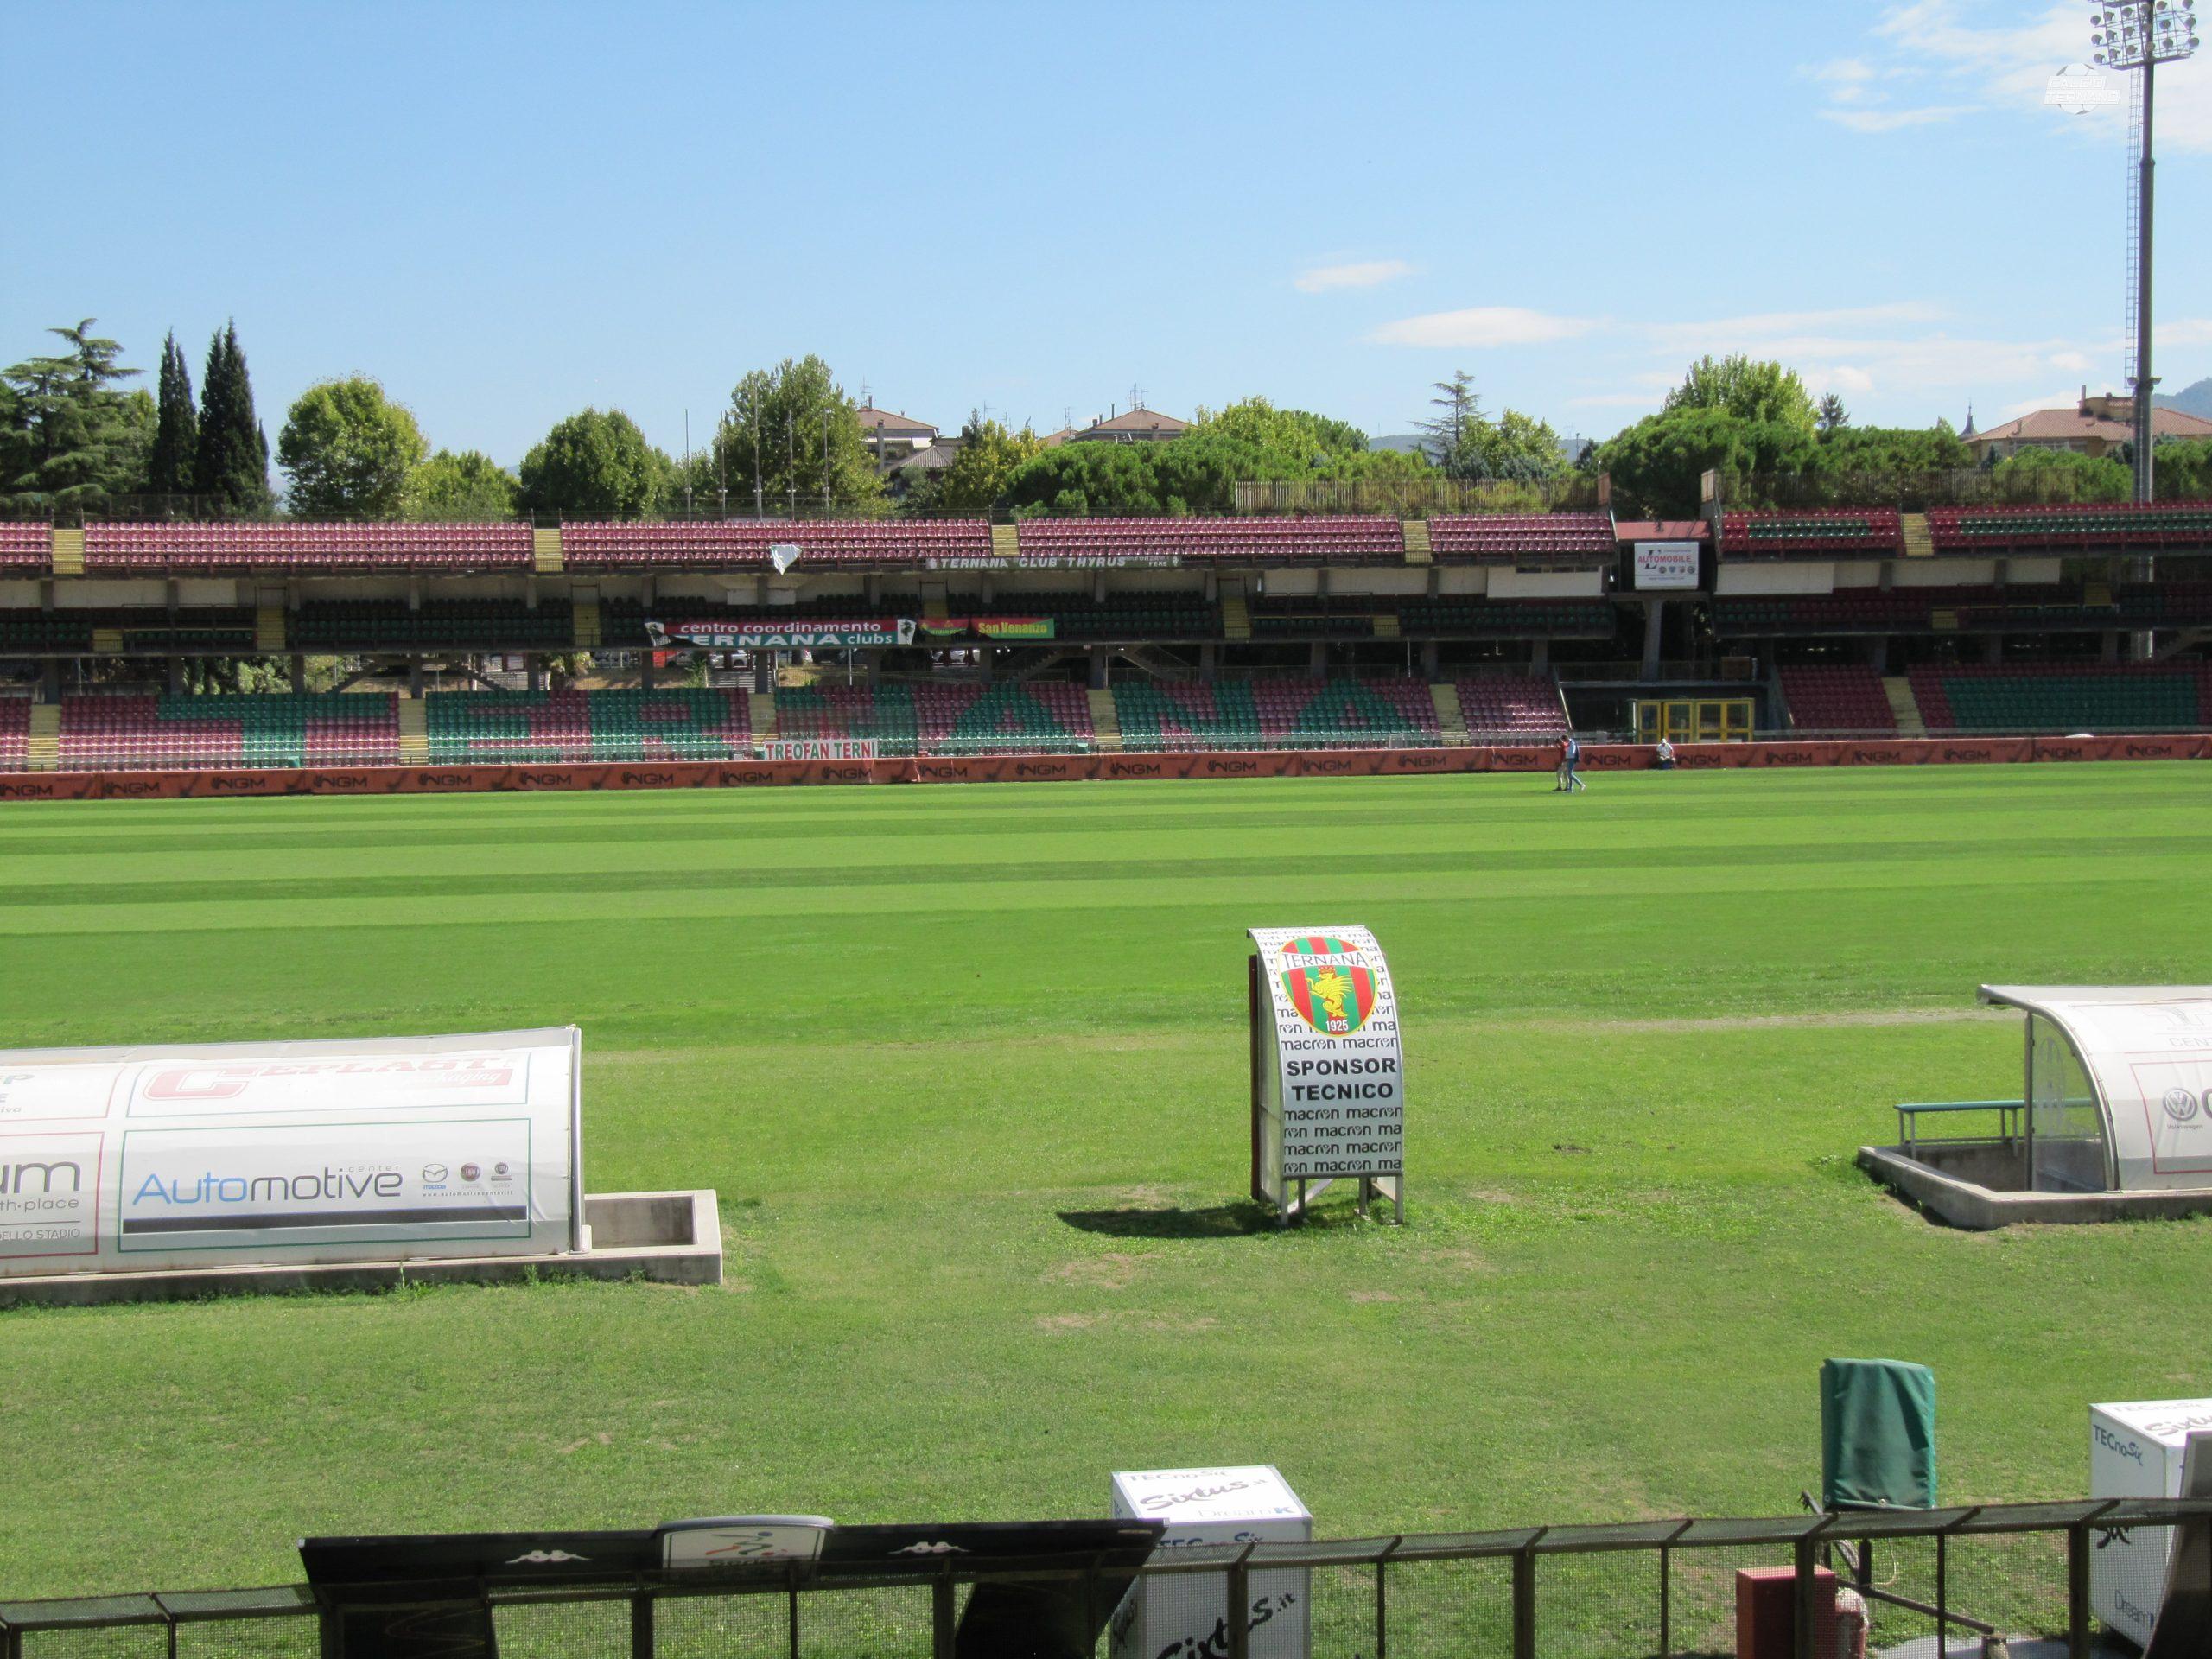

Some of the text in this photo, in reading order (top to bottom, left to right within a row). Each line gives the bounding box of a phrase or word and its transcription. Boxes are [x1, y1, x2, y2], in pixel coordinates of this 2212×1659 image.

[940, 557, 1009, 568] TERNANA
[1067, 556, 1127, 568] THYRUS
[1637, 555, 1693, 563] AUTOMOBILE
[680, 621, 881, 634] centro coordinamento
[978, 621, 1048, 633] San Venanzo
[847, 633, 893, 645] clubs
[765, 741, 875, 760] TREOFAN TERNI
[1860, 751, 1900, 761] NGM
[1952, 750, 1991, 760] NGM
[2038, 747, 2082, 758] NGM
[2132, 746, 2171, 757] NGM
[1404, 755, 1446, 767] NGM
[1497, 754, 1538, 766] NGM
[1590, 754, 1631, 766] NGM
[1681, 753, 1721, 766] NGM
[1771, 753, 1812, 764] NGM
[1022, 764, 1066, 776] NGM
[1117, 763, 1160, 775] NGM
[1214, 761, 1257, 772] NGM
[1312, 760, 1351, 771] NGM
[729, 772, 773, 783] NGM
[829, 767, 872, 779] NGM
[922, 766, 968, 778] NGM
[220, 777, 266, 789] NGM
[322, 776, 368, 787] NGM
[427, 773, 472, 786] NGM
[526, 773, 572, 785] NGM
[630, 772, 674, 785] NGM
[4, 784, 53, 796] NGM
[111, 782, 160, 794] NGM
[1282, 951, 1370, 969] TERNANA
[1325, 1020, 1349, 1033] 1925
[1281, 1037, 1398, 1051] macron macron
[1287, 1058, 1397, 1077] SPONSOR
[1291, 1082, 1394, 1101] TECNICO
[1284, 1106, 1401, 1121] macron macron
[1314, 1124, 1372, 1137] macron
[1284, 1141, 1401, 1156] macron macron
[348, 1164, 403, 1173] center
[1314, 1158, 1372, 1172] macron
[131, 1166, 404, 1205] Automotive
[0, 1228, 81, 1242] ELLO STADIO
